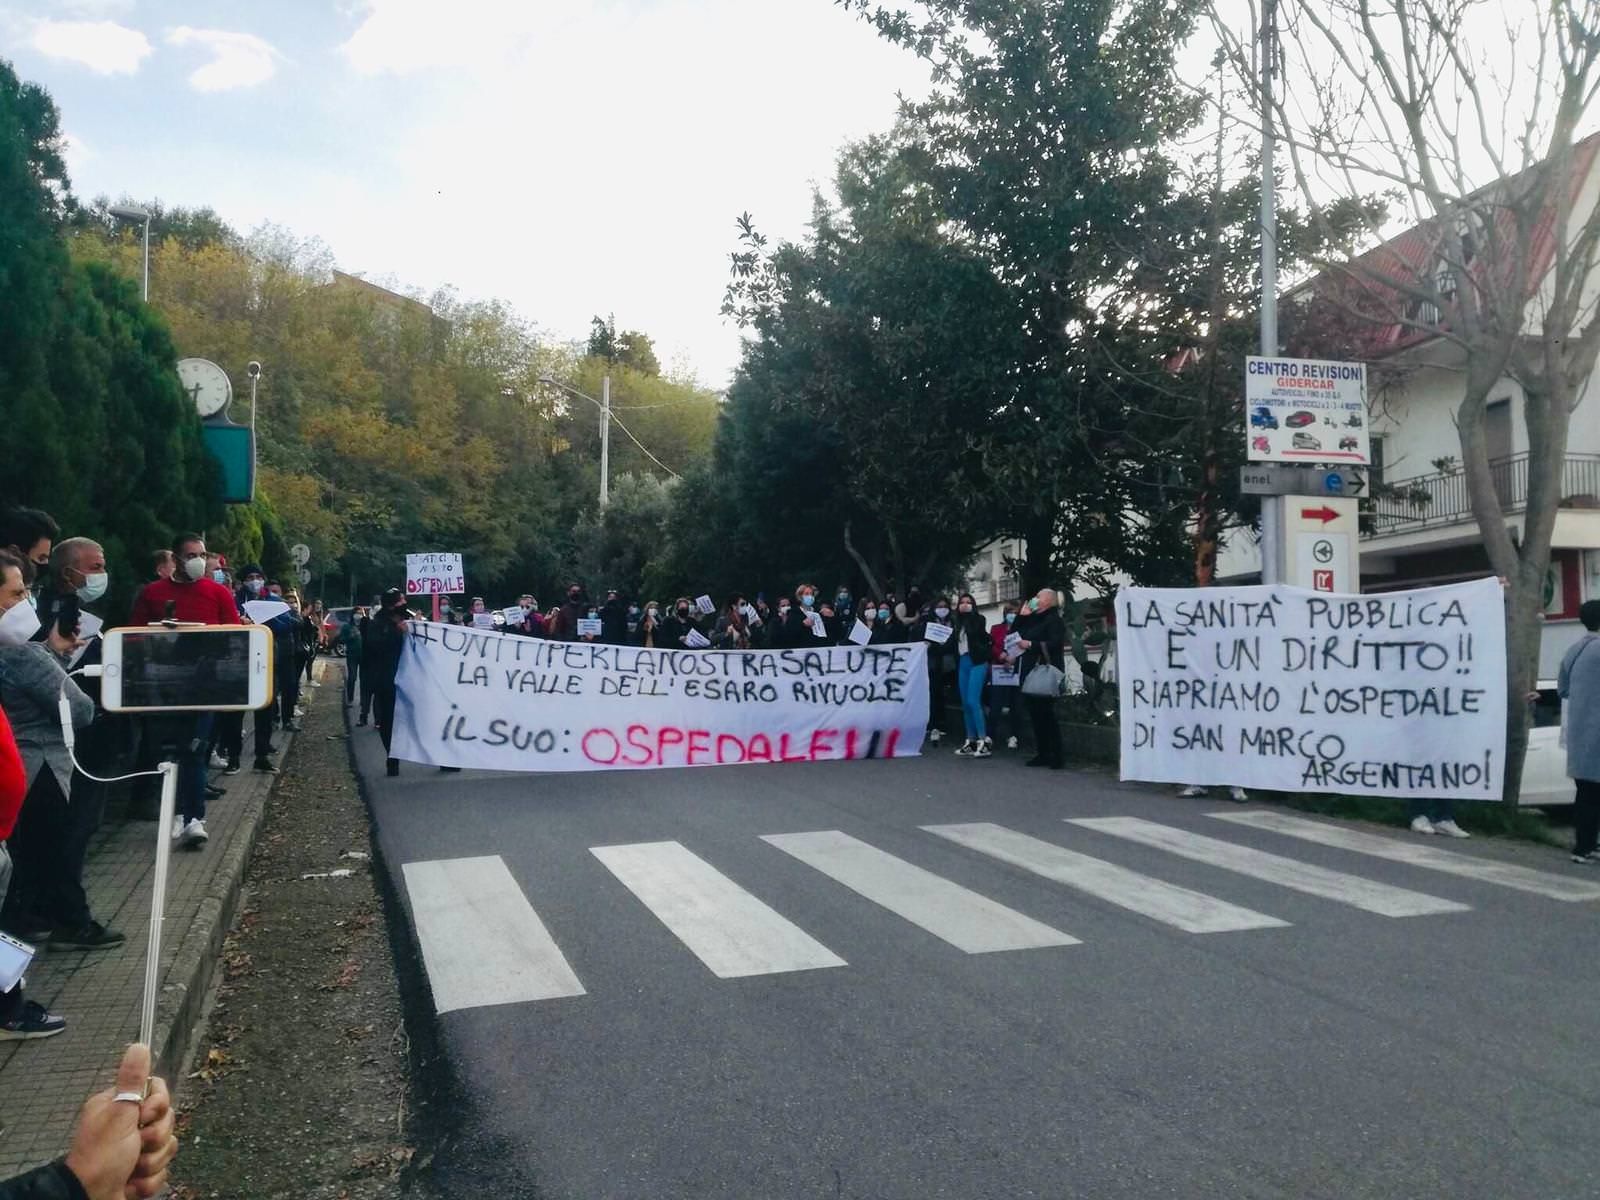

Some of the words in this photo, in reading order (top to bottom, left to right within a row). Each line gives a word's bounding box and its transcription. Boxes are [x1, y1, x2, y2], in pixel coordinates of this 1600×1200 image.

[1248, 361, 1298, 377] CENTRO
[1302, 364, 1362, 380] REVISIONI
[1277, 377, 1335, 389] GIDERCAR
[408, 577, 463, 593] OSPEDALE
[1127, 600, 1165, 628] LA
[1306, 597, 1468, 630] PUBBLICA
[1216, 636, 1260, 671] UN
[457, 661, 488, 686] LA
[505, 669, 583, 694] VALLE
[792, 678, 906, 705] RIVUOLE
[1132, 669, 1280, 712] RIAPRIAMO
[1299, 681, 1486, 718] L'OSPEDALE
[1172, 724, 1223, 751] SAN
[1239, 726, 1345, 761] MARCO
[1302, 749, 1492, 790] ARGENTANO!
